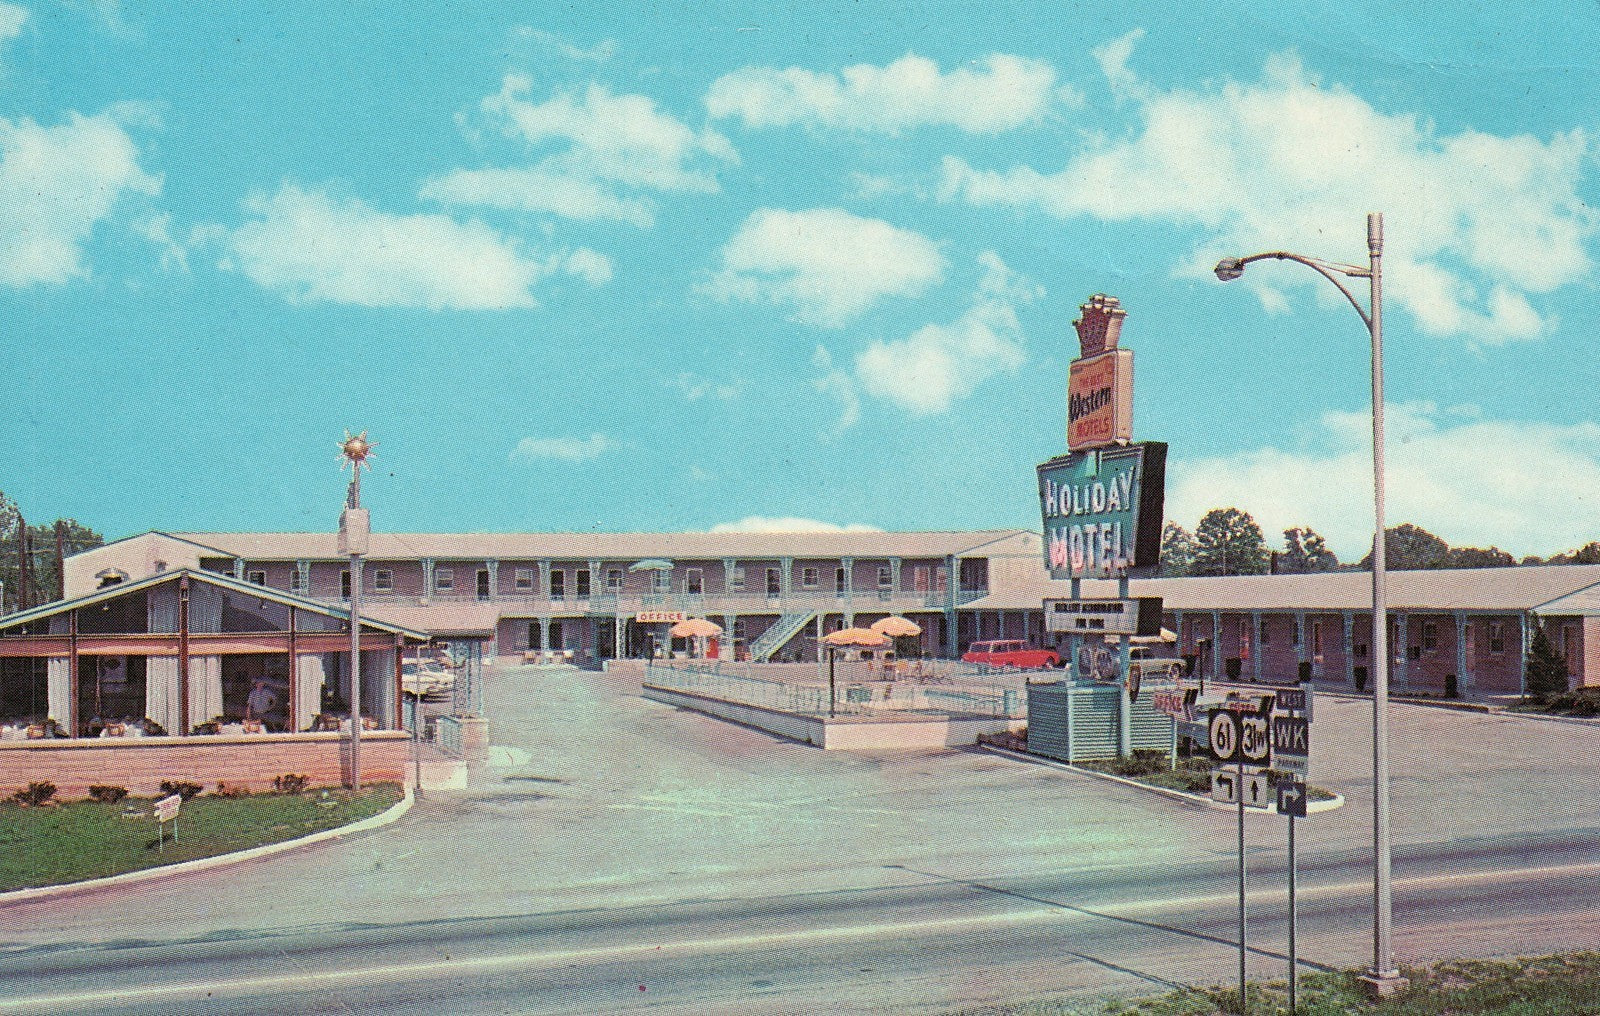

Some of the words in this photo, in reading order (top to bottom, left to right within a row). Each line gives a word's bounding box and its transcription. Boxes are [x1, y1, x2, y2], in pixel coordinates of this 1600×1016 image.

[1070, 387, 1111, 424] Western
[1076, 417, 1109, 437] MOTELS
[1045, 466, 1135, 518] HOLIDAY
[1049, 520, 1130, 573] MOTEL
[640, 612, 683, 621] OFFICE
[1216, 722, 1232, 751] 61
[1243, 723, 1267, 753] 31W
[1277, 724, 1306, 751] WK
